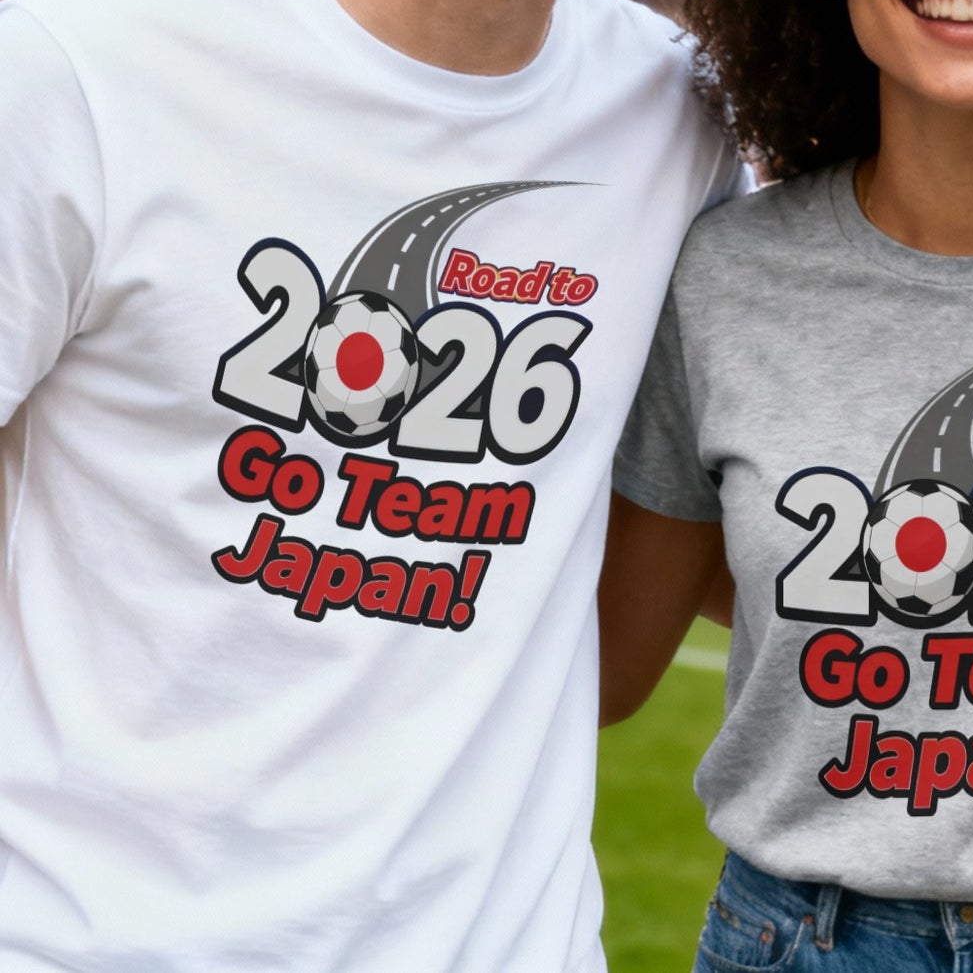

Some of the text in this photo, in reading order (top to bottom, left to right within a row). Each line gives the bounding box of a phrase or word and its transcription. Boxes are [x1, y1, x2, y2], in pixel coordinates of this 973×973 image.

[439, 248, 598, 306] Road to
[212, 237, 593, 466] 2026
[218, 424, 535, 544] Go Team
[211, 513, 491, 632] Japan!
[800, 628, 910, 708] Go
